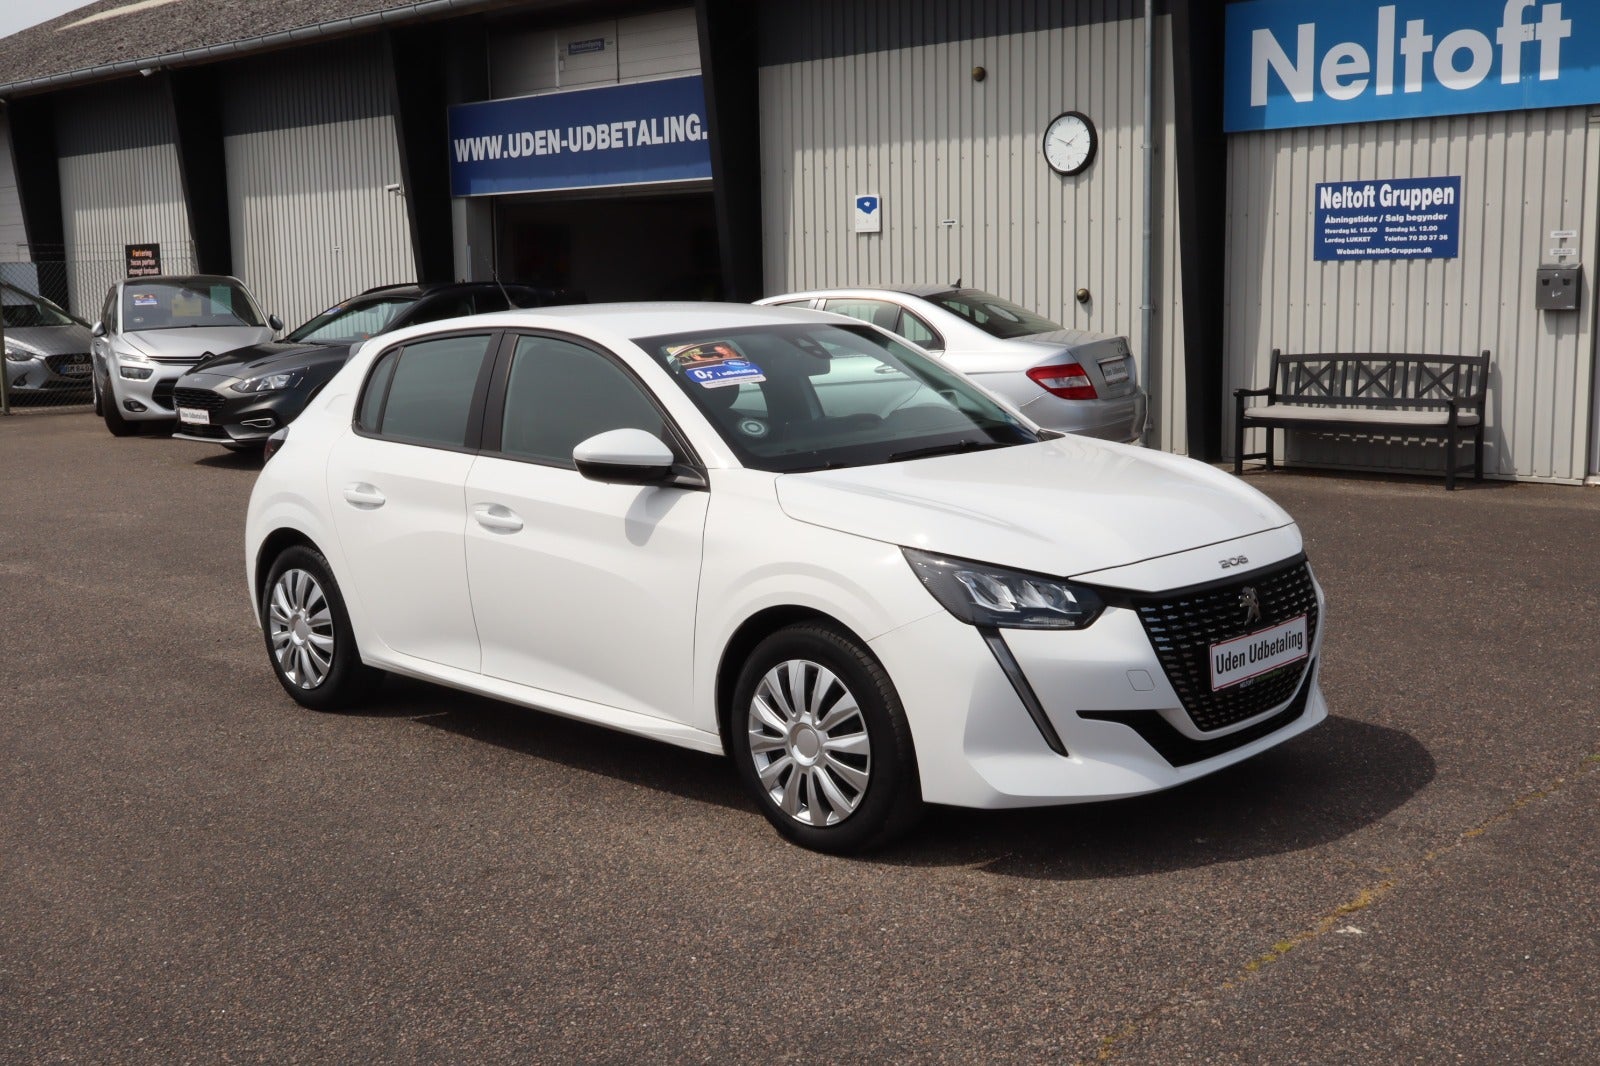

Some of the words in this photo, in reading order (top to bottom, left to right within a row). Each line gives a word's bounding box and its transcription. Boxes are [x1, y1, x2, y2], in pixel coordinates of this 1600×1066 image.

[1251, 0, 1572, 107] Neltoft
[454, 113, 708, 163] WWW.UDEN-UDBETALING.
[1320, 185, 1376, 209] Neltoft
[1380, 184, 1455, 211] Gruppen
[1325, 214, 1378, 224] Åbningstider
[1385, 214, 1404, 223] Salg
[1406, 213, 1448, 222] begynder
[1366, 247, 1432, 255] Neltoft-Gruppen.dk
[1218, 555, 1249, 569] 208
[1216, 651, 1246, 675] Uden
[1249, 631, 1303, 663] Udbetaling
